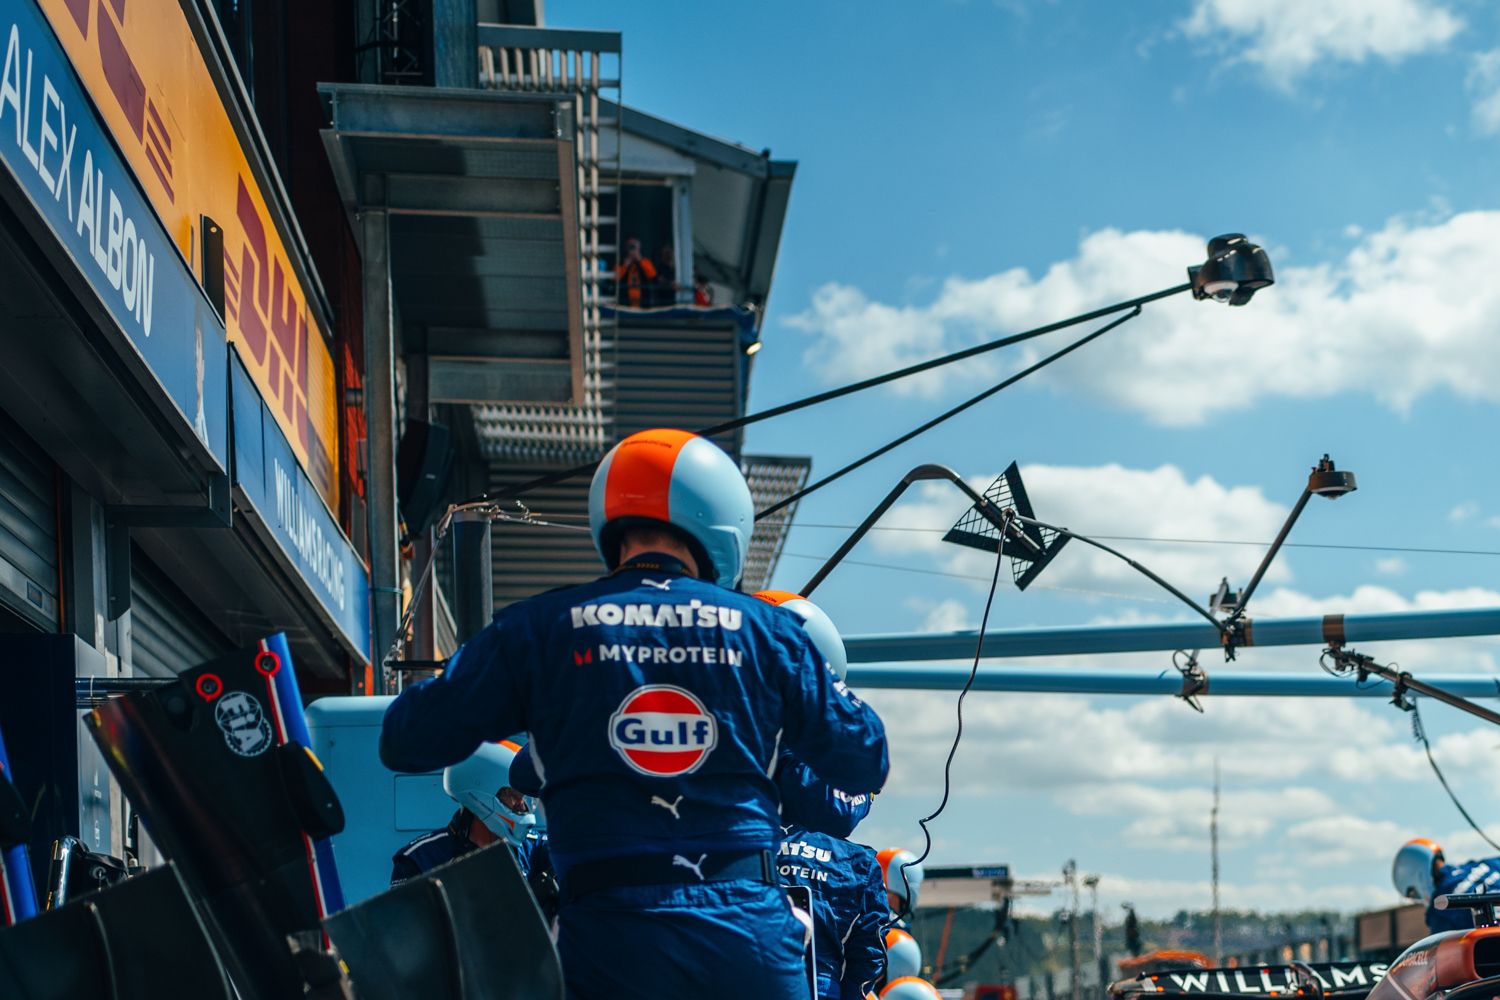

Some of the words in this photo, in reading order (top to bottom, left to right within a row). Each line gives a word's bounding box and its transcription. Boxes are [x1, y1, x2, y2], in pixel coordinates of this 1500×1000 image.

[0, 23, 77, 223] ALEX
[77, 149, 155, 338] ALBON
[274, 457, 317, 573] WILLIAMS
[571, 599, 742, 631] KOMATSU
[600, 644, 743, 667] MYPROTEIN
[615, 717, 709, 746] Gulf
